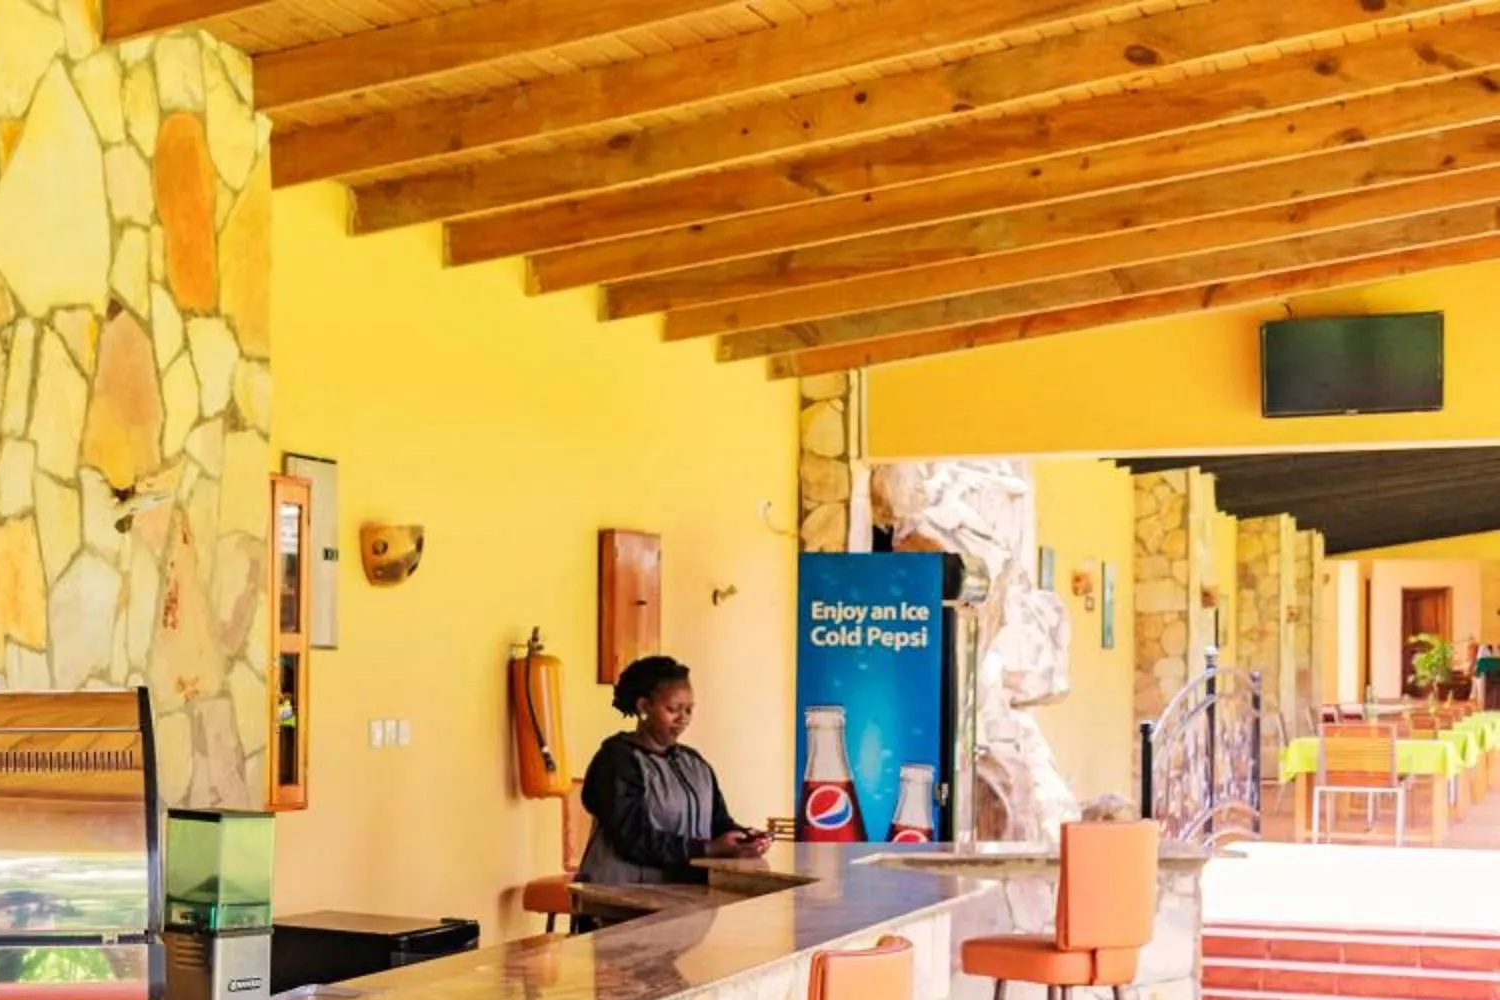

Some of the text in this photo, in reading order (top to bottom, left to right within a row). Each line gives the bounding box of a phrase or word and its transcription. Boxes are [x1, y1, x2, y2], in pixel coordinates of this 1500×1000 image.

[811, 600, 929, 624] Enjoy an Ice
[810, 626, 928, 652] Cold Pepsi
